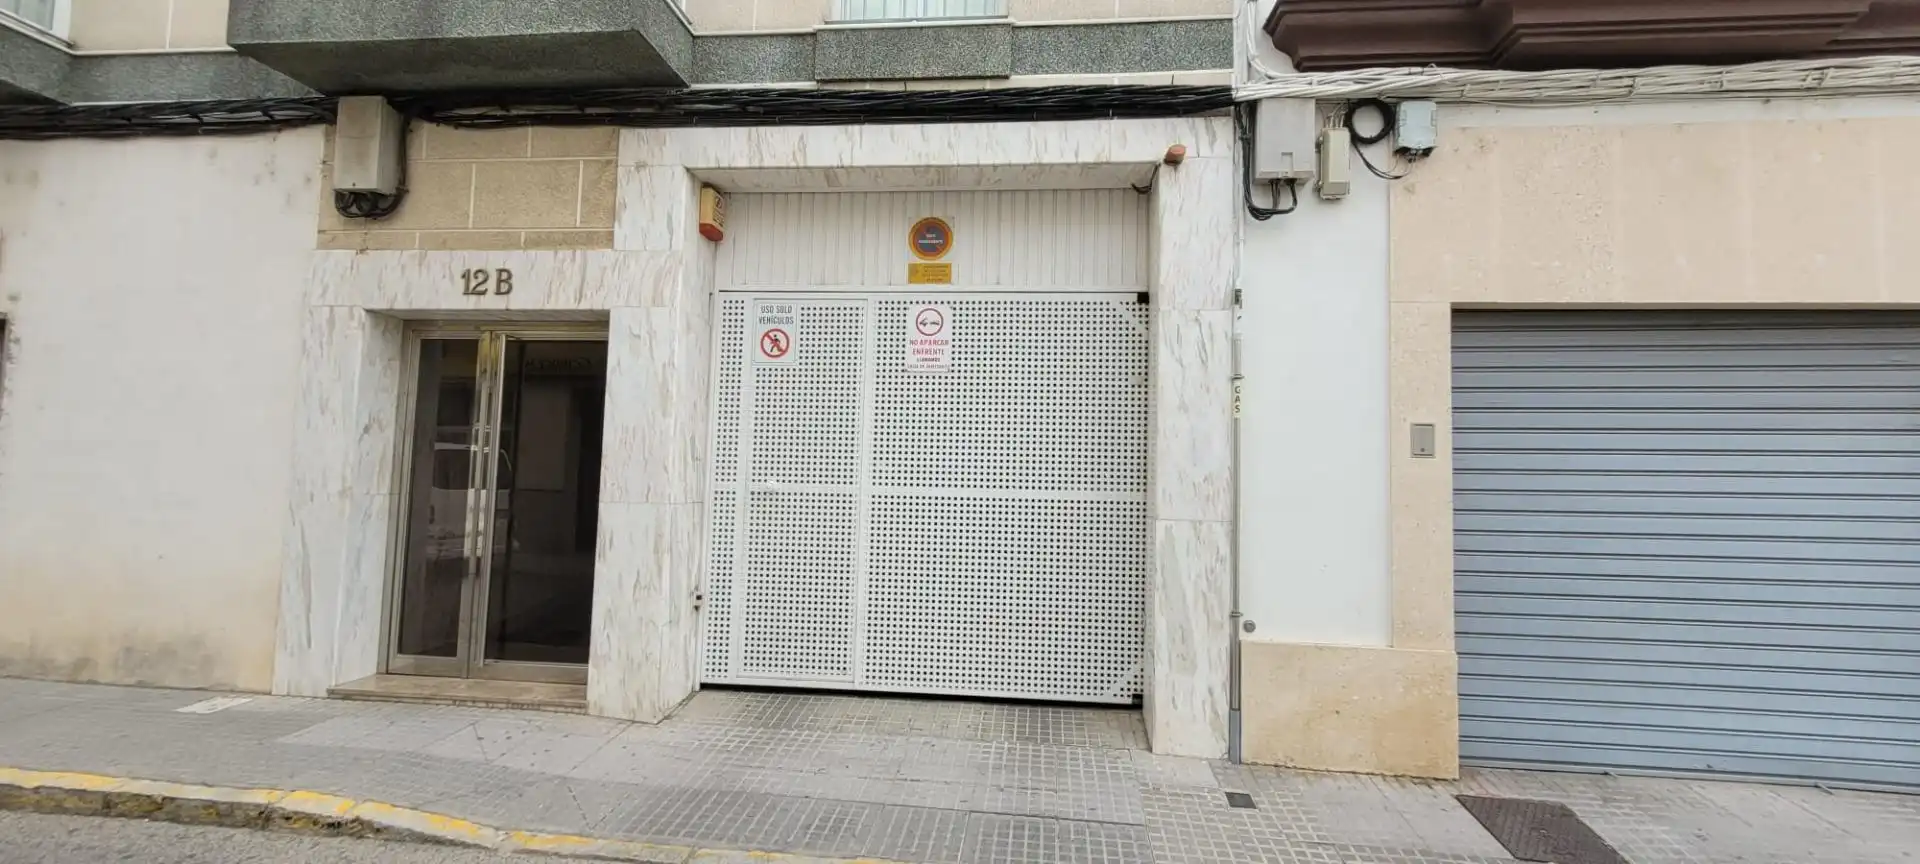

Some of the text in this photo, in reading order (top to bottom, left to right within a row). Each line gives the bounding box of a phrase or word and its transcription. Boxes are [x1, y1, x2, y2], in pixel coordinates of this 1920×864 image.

[461, 268, 513, 295] 12 B
[760, 305, 793, 314] USO SOLO
